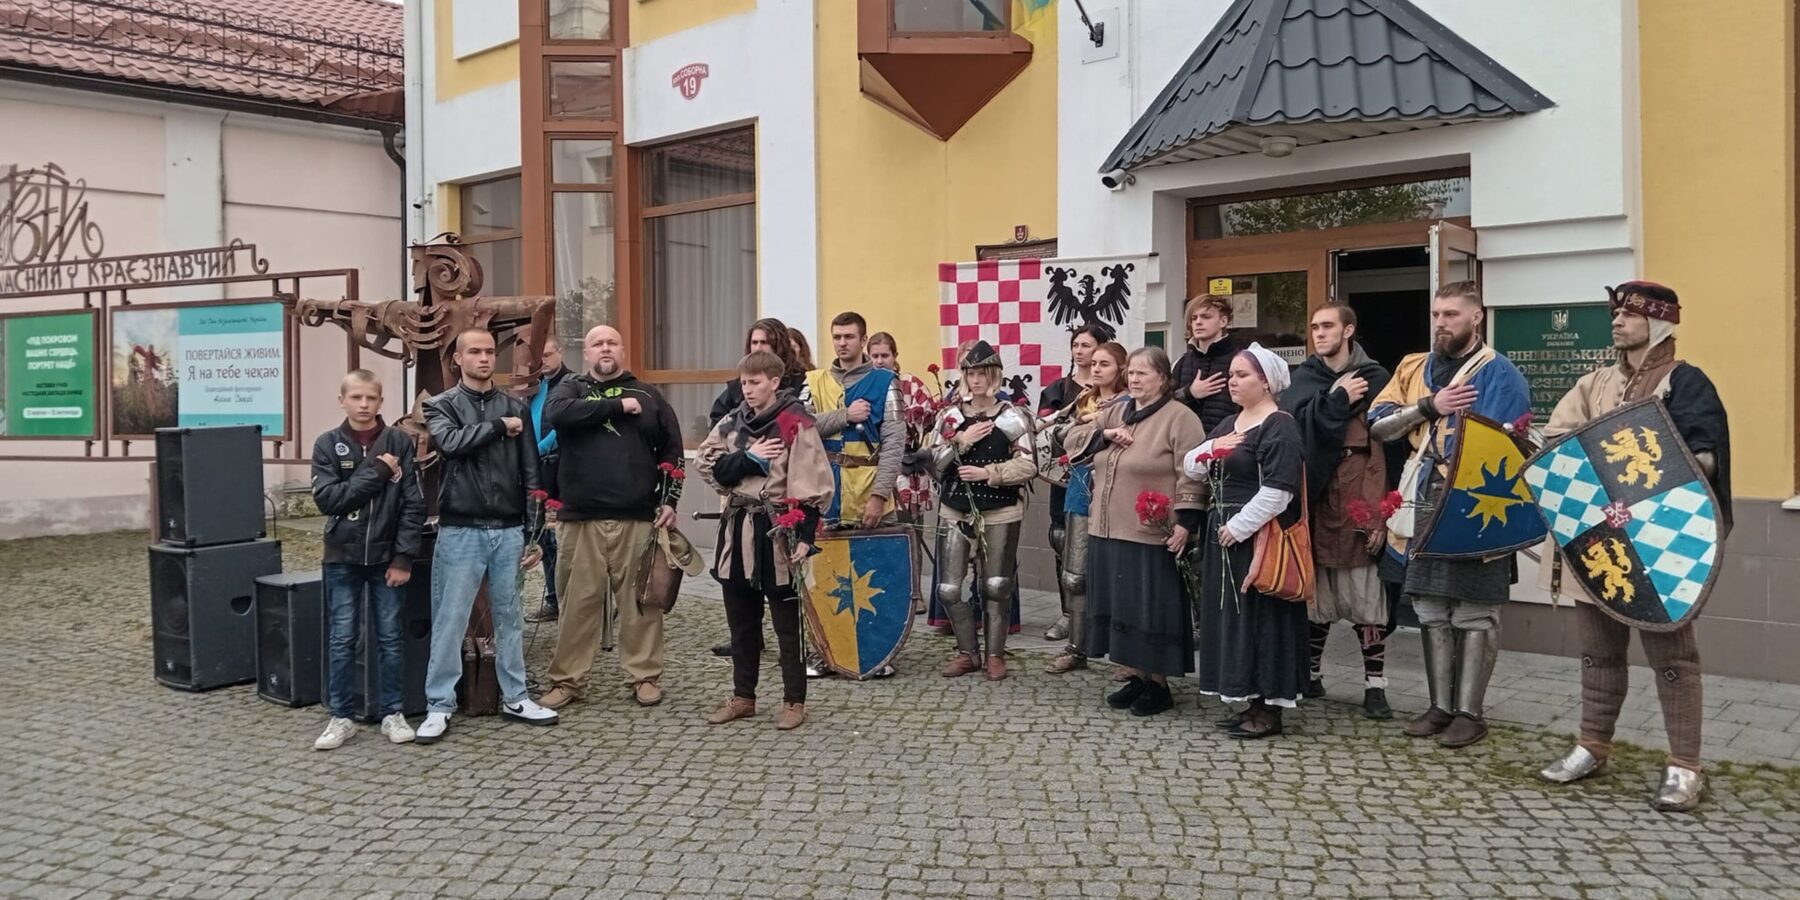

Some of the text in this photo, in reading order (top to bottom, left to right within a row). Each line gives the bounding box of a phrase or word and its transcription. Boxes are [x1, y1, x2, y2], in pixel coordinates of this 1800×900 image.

[683, 76, 697, 97] 19
[1541, 332, 1580, 340] УКРАЇНА
[185, 347, 241, 361] ПОВЕРТАЙСЯ
[1274, 349, 1304, 357] ИНЕНО
[1507, 346, 1617, 362] ВІННИЦЬКИЙ
[187, 364, 280, 381] Я на тебе чекаю
